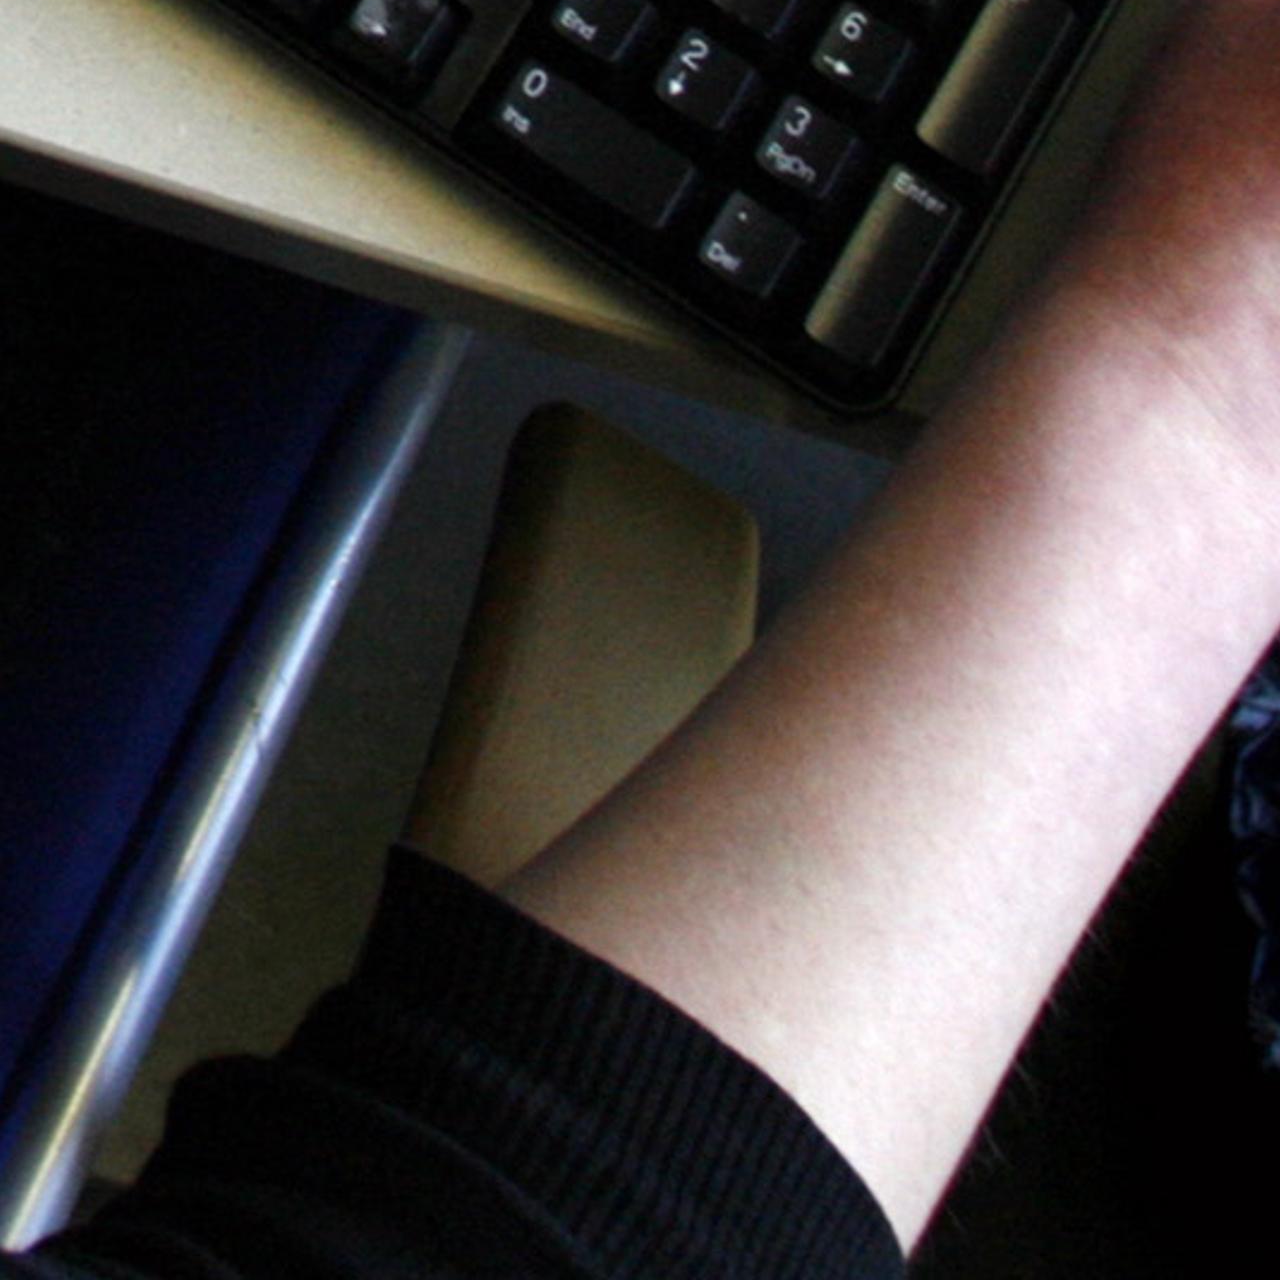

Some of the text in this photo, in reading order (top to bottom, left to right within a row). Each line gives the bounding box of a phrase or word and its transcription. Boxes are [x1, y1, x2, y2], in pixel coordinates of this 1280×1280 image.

[559, 5, 598, 42] End
[839, 10, 868, 41] 6
[680, 37, 710, 71] 2
[521, 67, 550, 99] 0
[500, 104, 532, 135] Ins
[783, 104, 812, 137] 3
[764, 142, 817, 184] PgDn
[892, 170, 949, 216] Enter
[704, 239, 743, 274] Del
